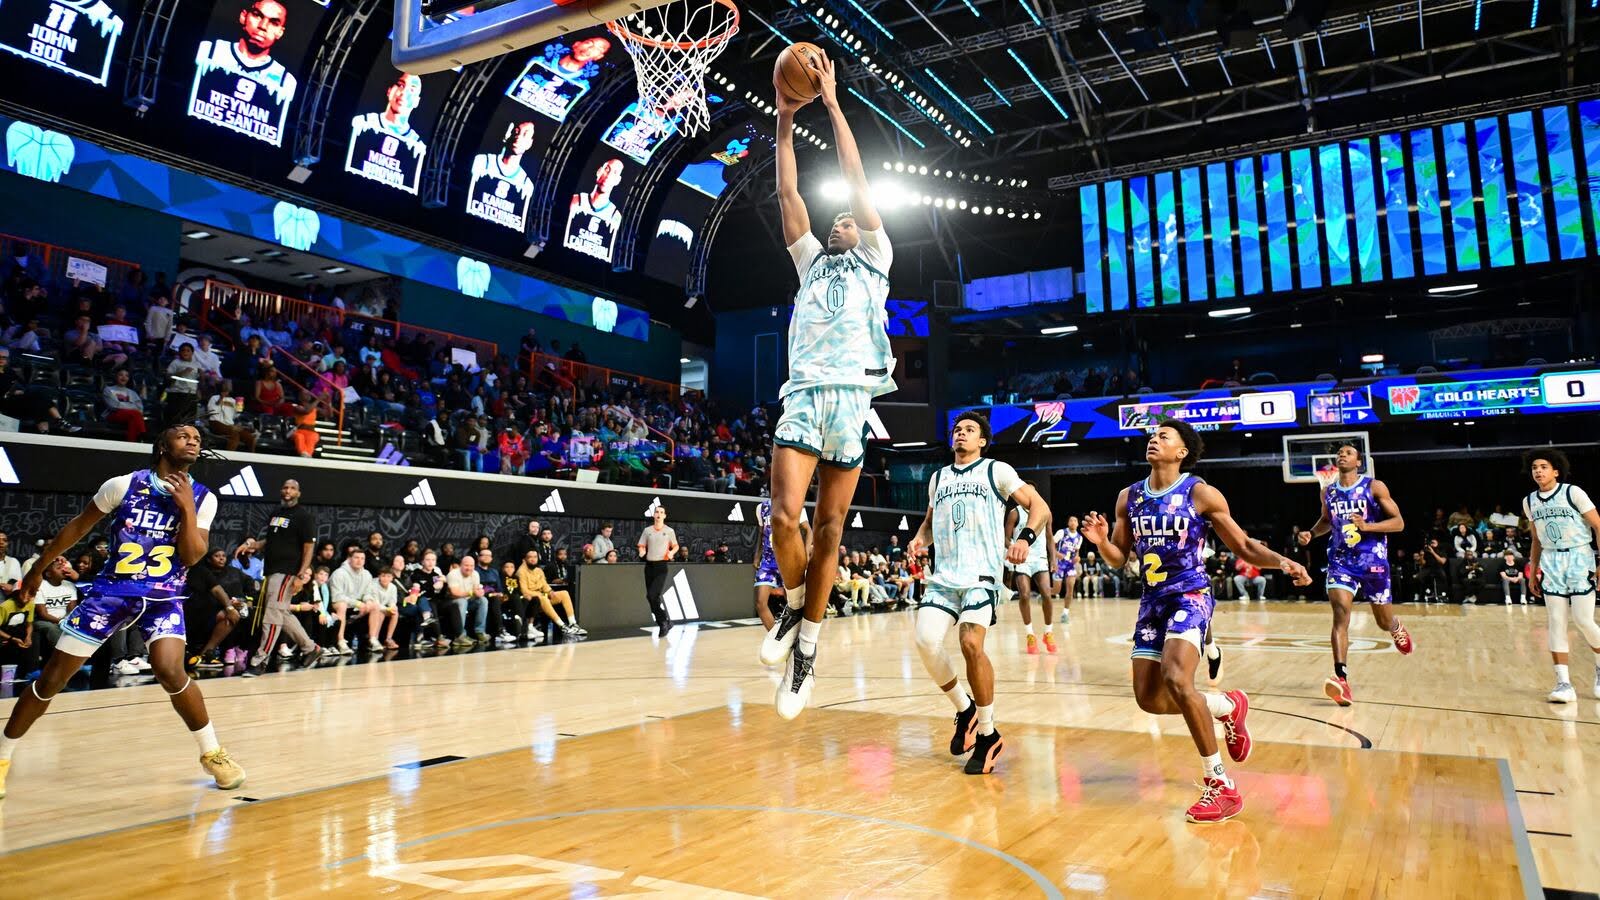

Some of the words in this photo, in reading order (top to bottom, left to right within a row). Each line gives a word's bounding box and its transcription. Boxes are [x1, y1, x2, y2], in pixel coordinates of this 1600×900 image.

[46, 3, 78, 33] 11
[27, 24, 77, 52] JOHN
[30, 39, 66, 65] BOL
[234, 78, 256, 101] 9
[210, 90, 269, 123] REYNAN
[195, 99, 224, 120] DOS
[225, 111, 277, 139] SANTOS
[381, 136, 399, 156] 0
[368, 150, 402, 172] MIKEL
[472, 200, 521, 228] CATCHINGS
[588, 217, 601, 233] 6
[827, 275, 844, 315] 6
[1435, 391, 1473, 403] COLD
[1477, 387, 1540, 400] HEARTS
[1567, 380, 1585, 397] 0
[1173, 408, 1208, 419] JELLY
[1211, 406, 1239, 417] FAM
[1261, 401, 1274, 415] 0
[954, 482, 987, 499] HEARTS
[952, 500, 965, 532] 9
[1331, 500, 1367, 516] JELLY
[126, 509, 182, 531] JELL
[1131, 516, 1190, 538] JELLY
[1342, 524, 1361, 545] 3
[1545, 521, 1561, 543] 0
[115, 542, 175, 577] 23
[1143, 553, 1168, 582] 2
